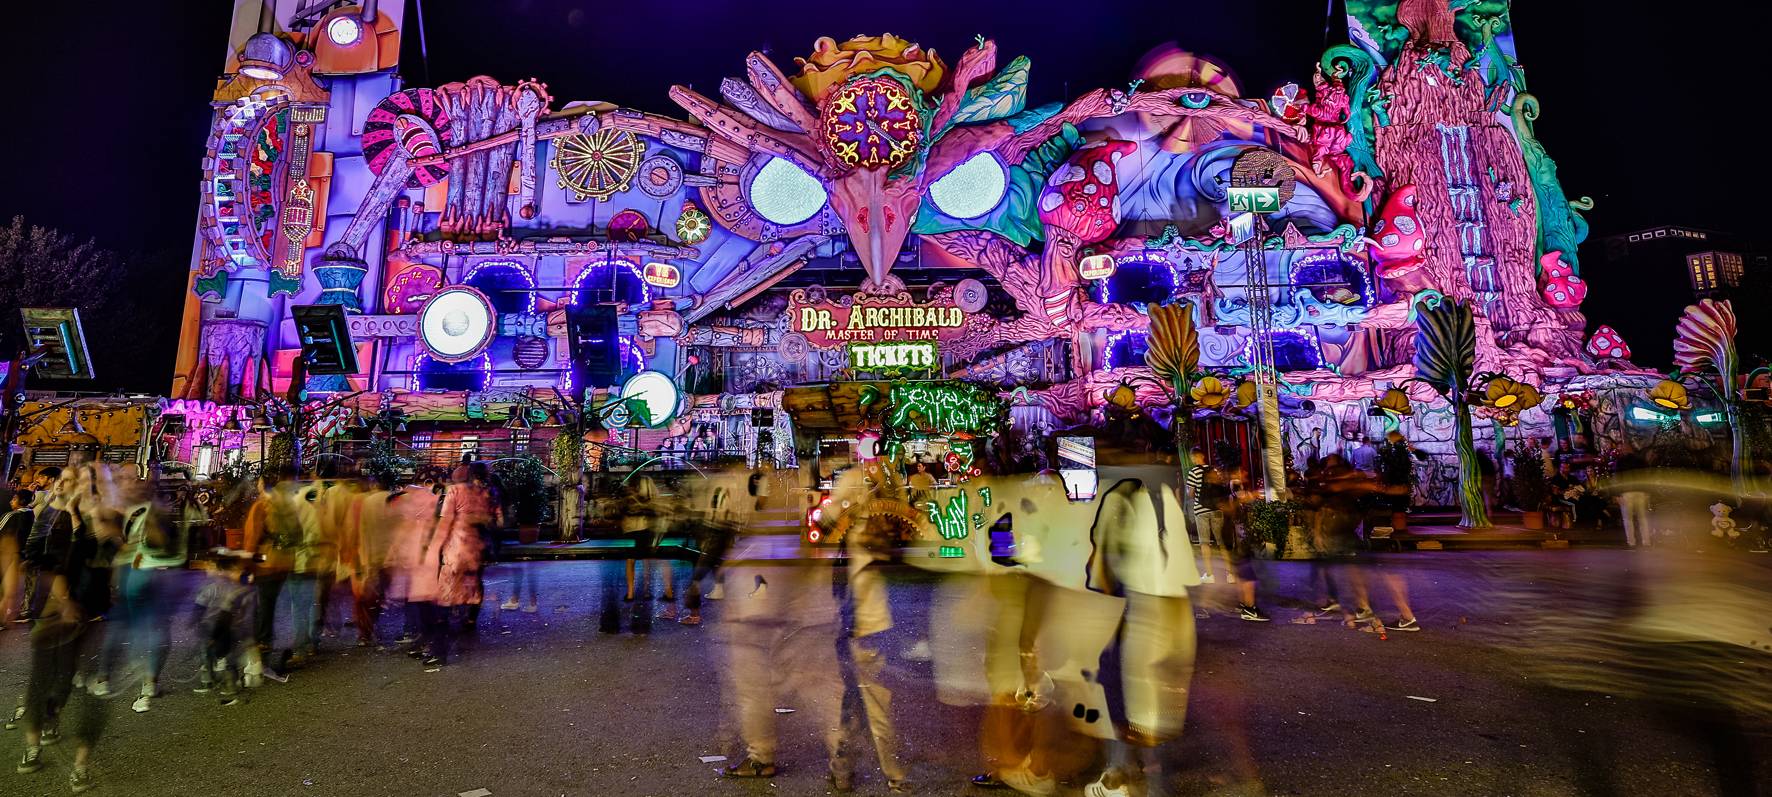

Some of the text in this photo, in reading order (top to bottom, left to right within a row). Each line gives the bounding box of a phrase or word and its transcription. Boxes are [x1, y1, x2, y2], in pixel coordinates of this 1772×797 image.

[848, 305, 963, 330] ARCHIBALD
[825, 329, 875, 340] MASTER
[884, 329, 899, 340] OF
[851, 345, 933, 367] TICKETS
[1266, 389, 1273, 398] 9
